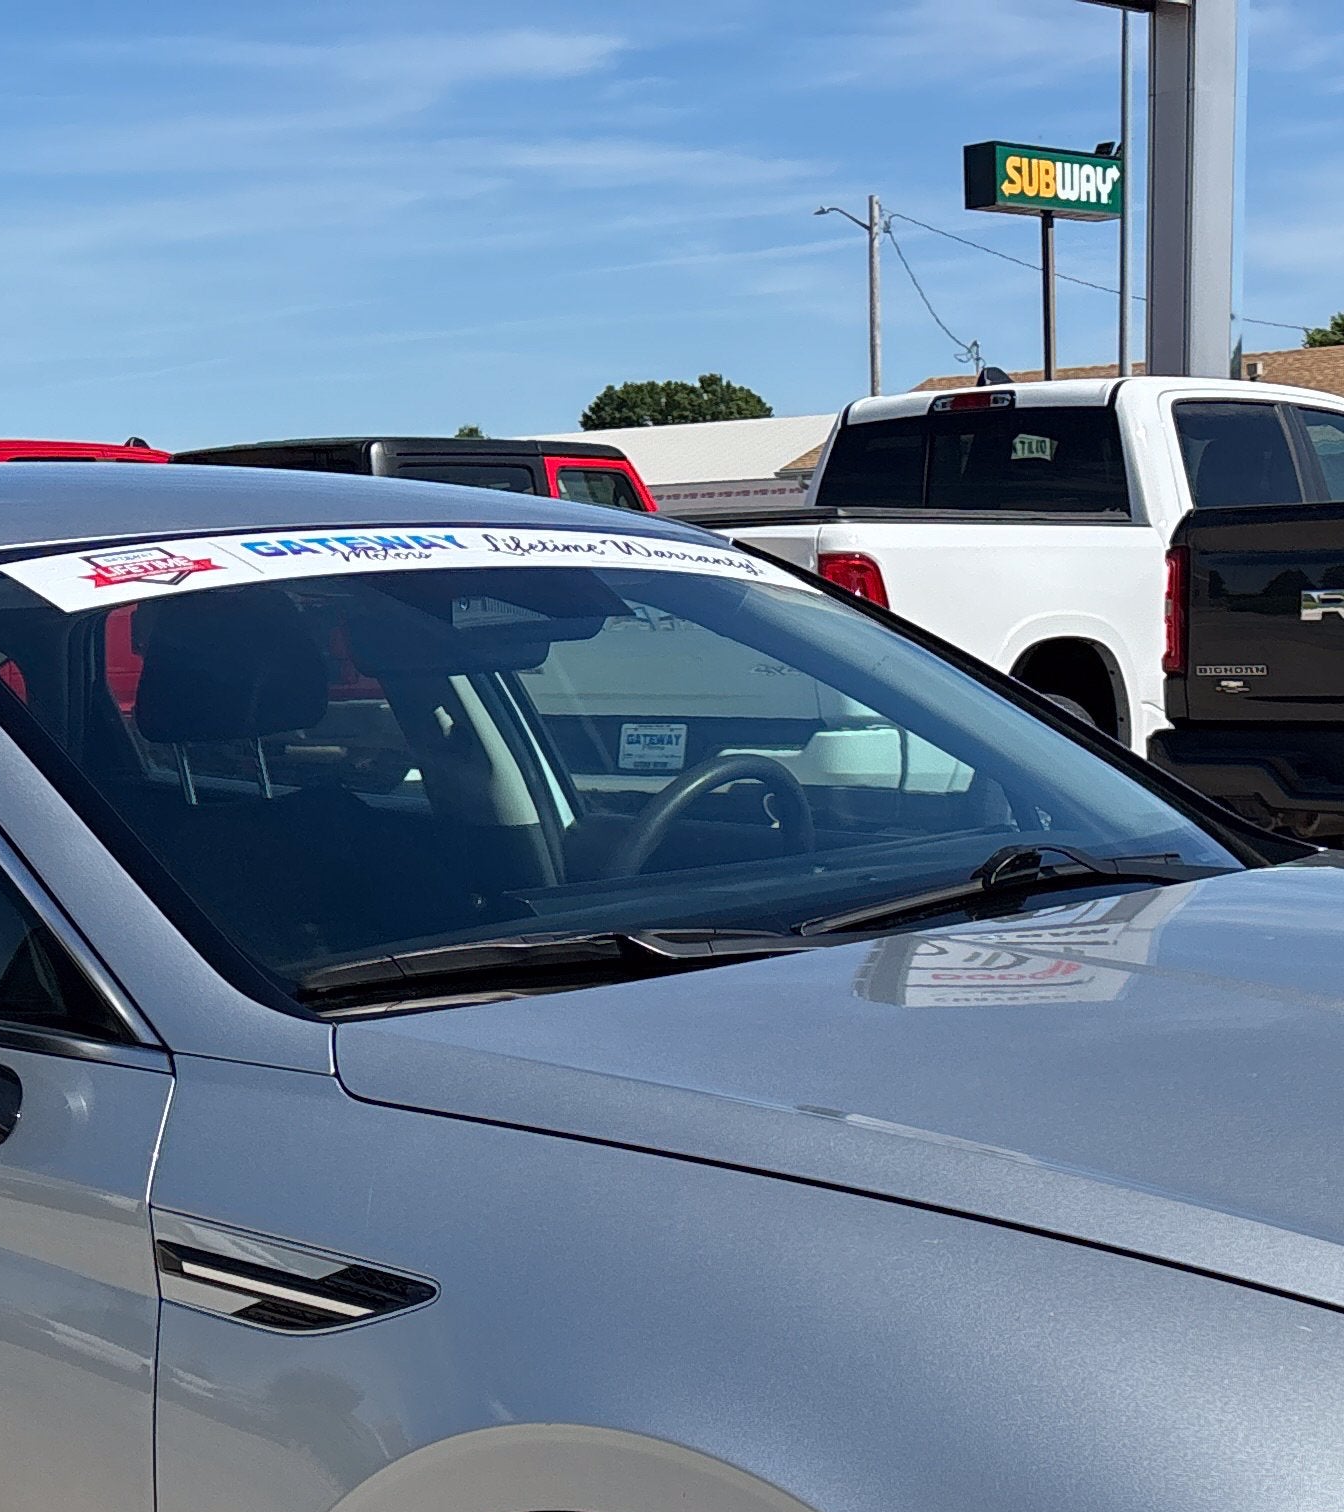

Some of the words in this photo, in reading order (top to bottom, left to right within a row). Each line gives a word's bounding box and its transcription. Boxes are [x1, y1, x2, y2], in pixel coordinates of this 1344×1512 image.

[1001, 156, 1120, 203] SUBWAY
[240, 534, 468, 557] GATEWAY
[481, 533, 605, 557] Lifetime
[96, 557, 194, 578] LIFETIME
[626, 734, 682, 746] GATEWAY
